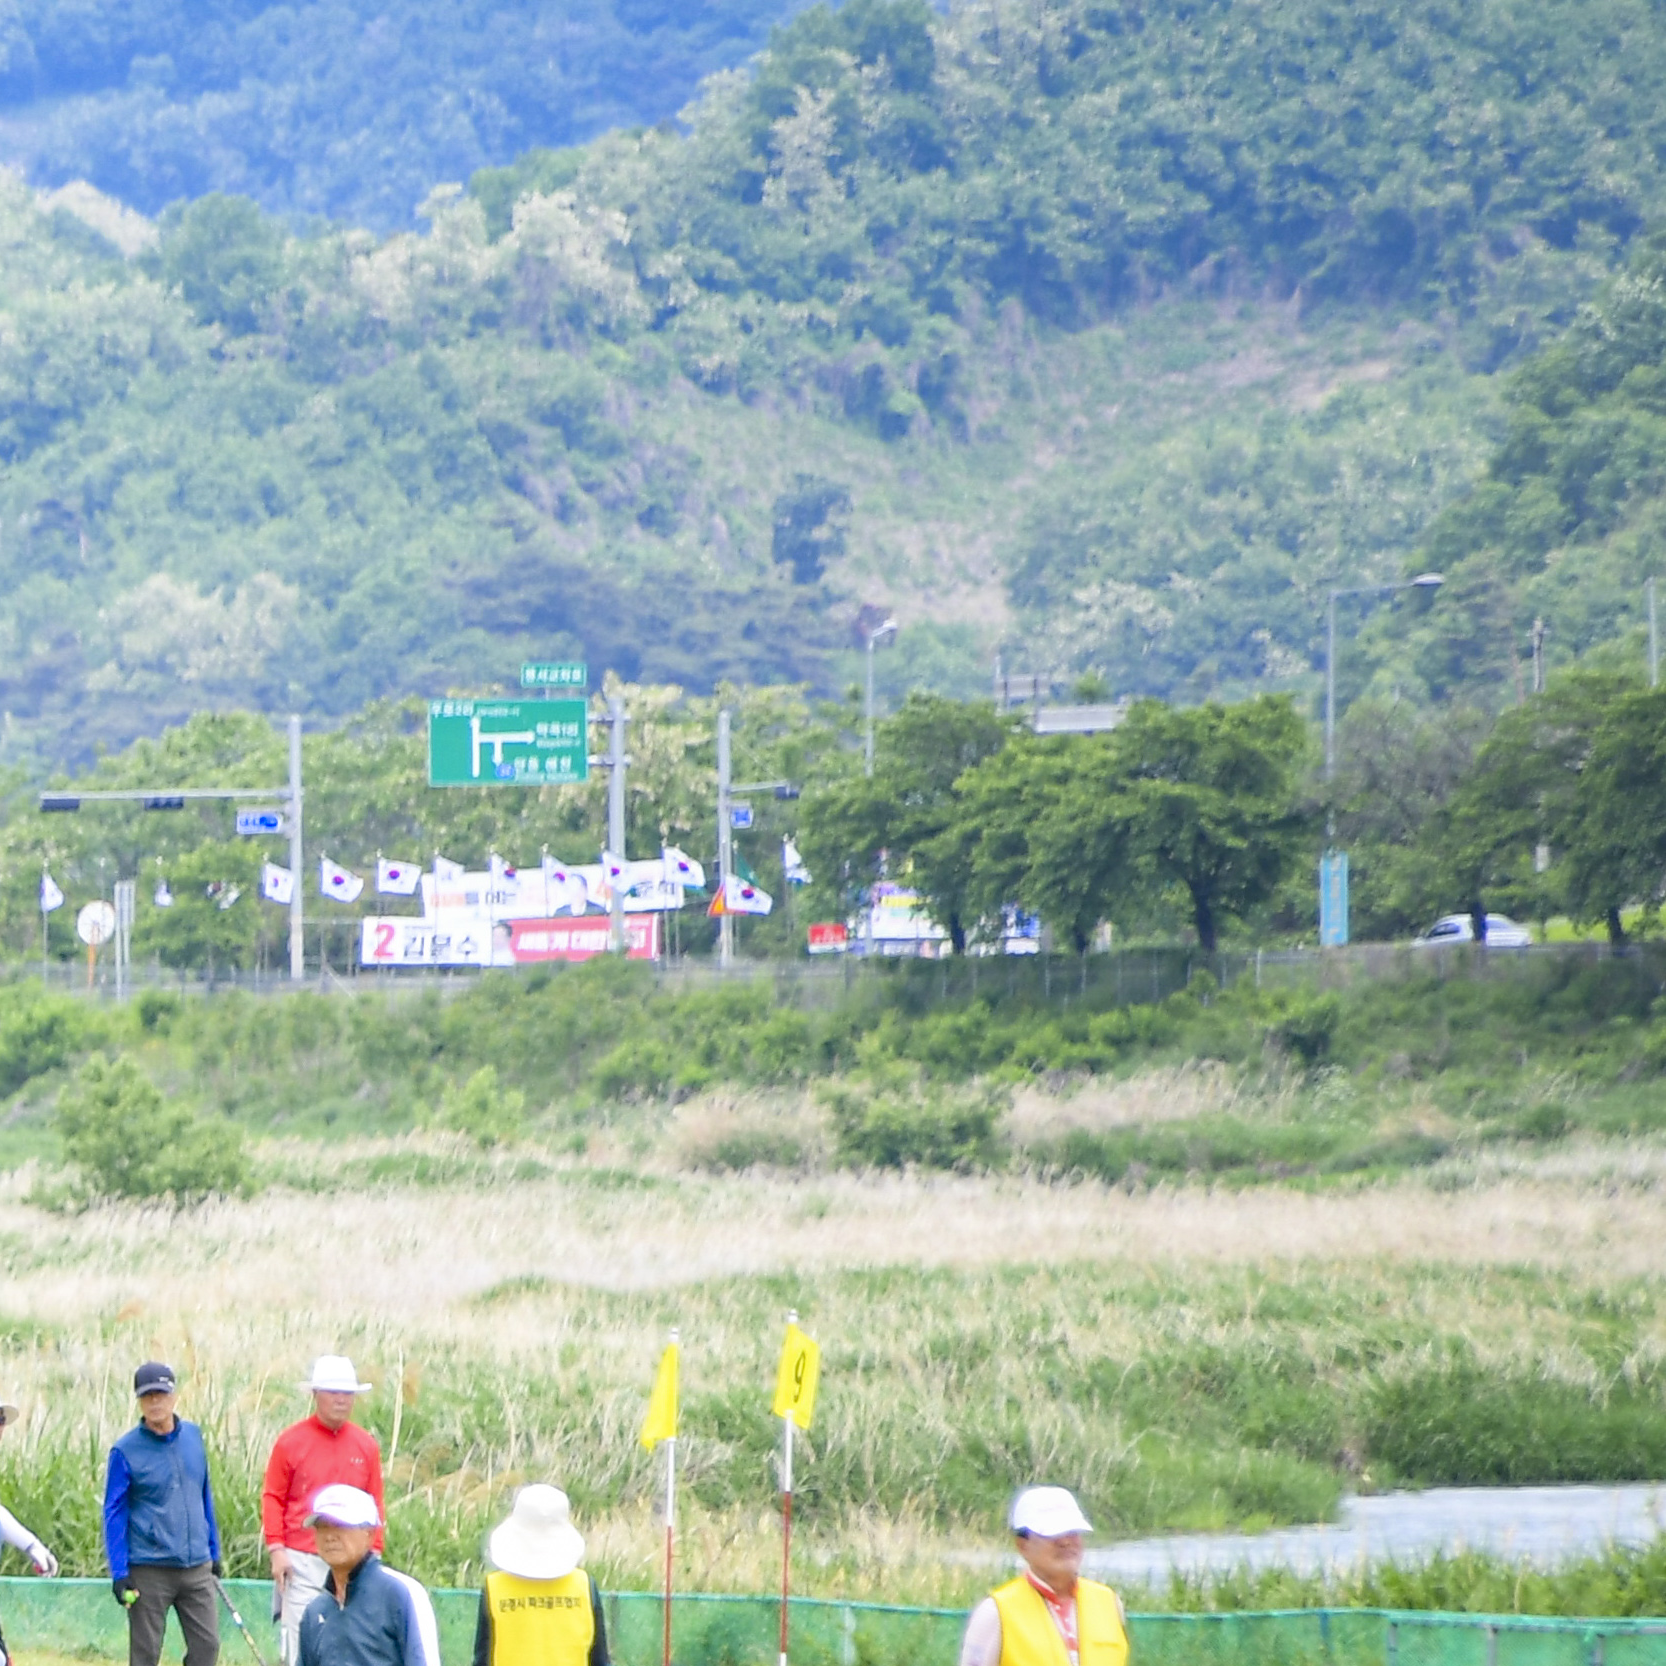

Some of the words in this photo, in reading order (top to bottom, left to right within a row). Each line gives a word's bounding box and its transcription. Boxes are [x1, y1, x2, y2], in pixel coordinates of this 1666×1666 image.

[373, 924, 396, 958] 2
[403, 936, 479, 957] 김문수
[793, 1350, 806, 1403] 9
